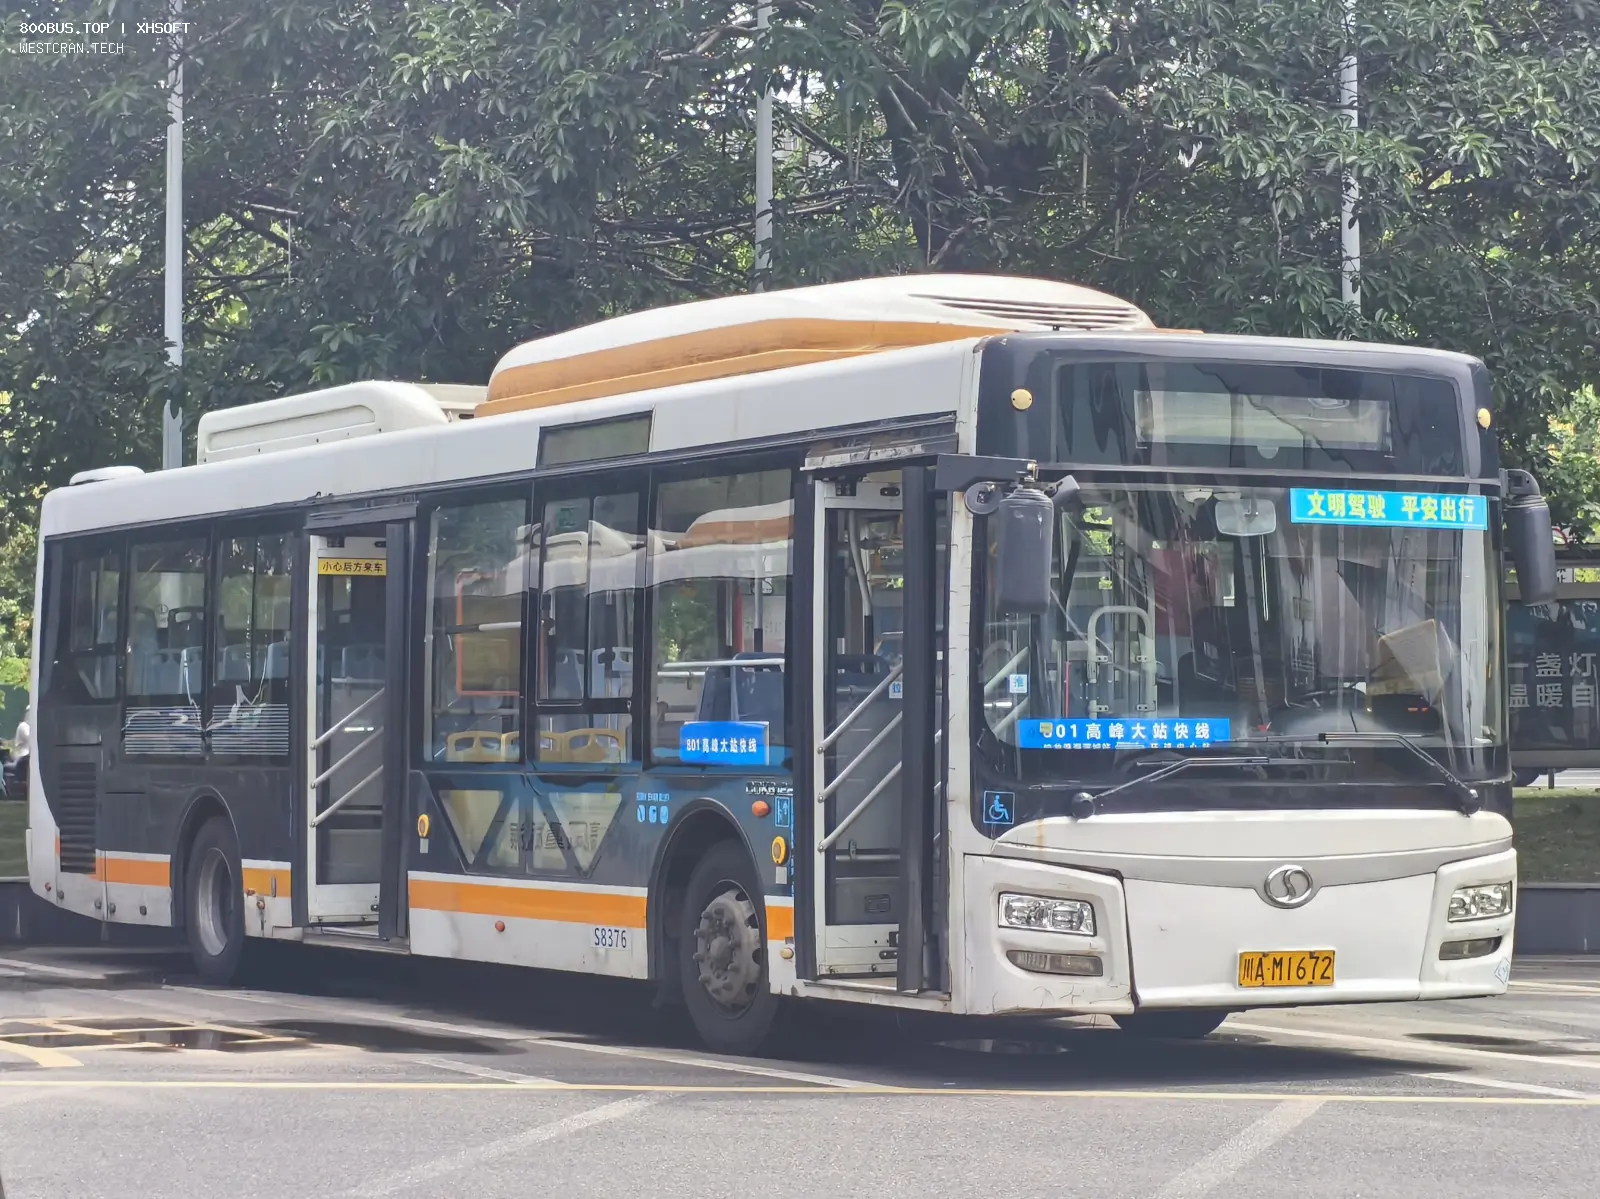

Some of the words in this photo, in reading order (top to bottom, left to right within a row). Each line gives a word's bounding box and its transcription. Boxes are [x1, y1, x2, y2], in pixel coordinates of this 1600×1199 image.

[1307, 491, 1386, 519] 文明驾驶
[1401, 495, 1475, 522] 平安出行
[594, 926, 627, 948] S8376
